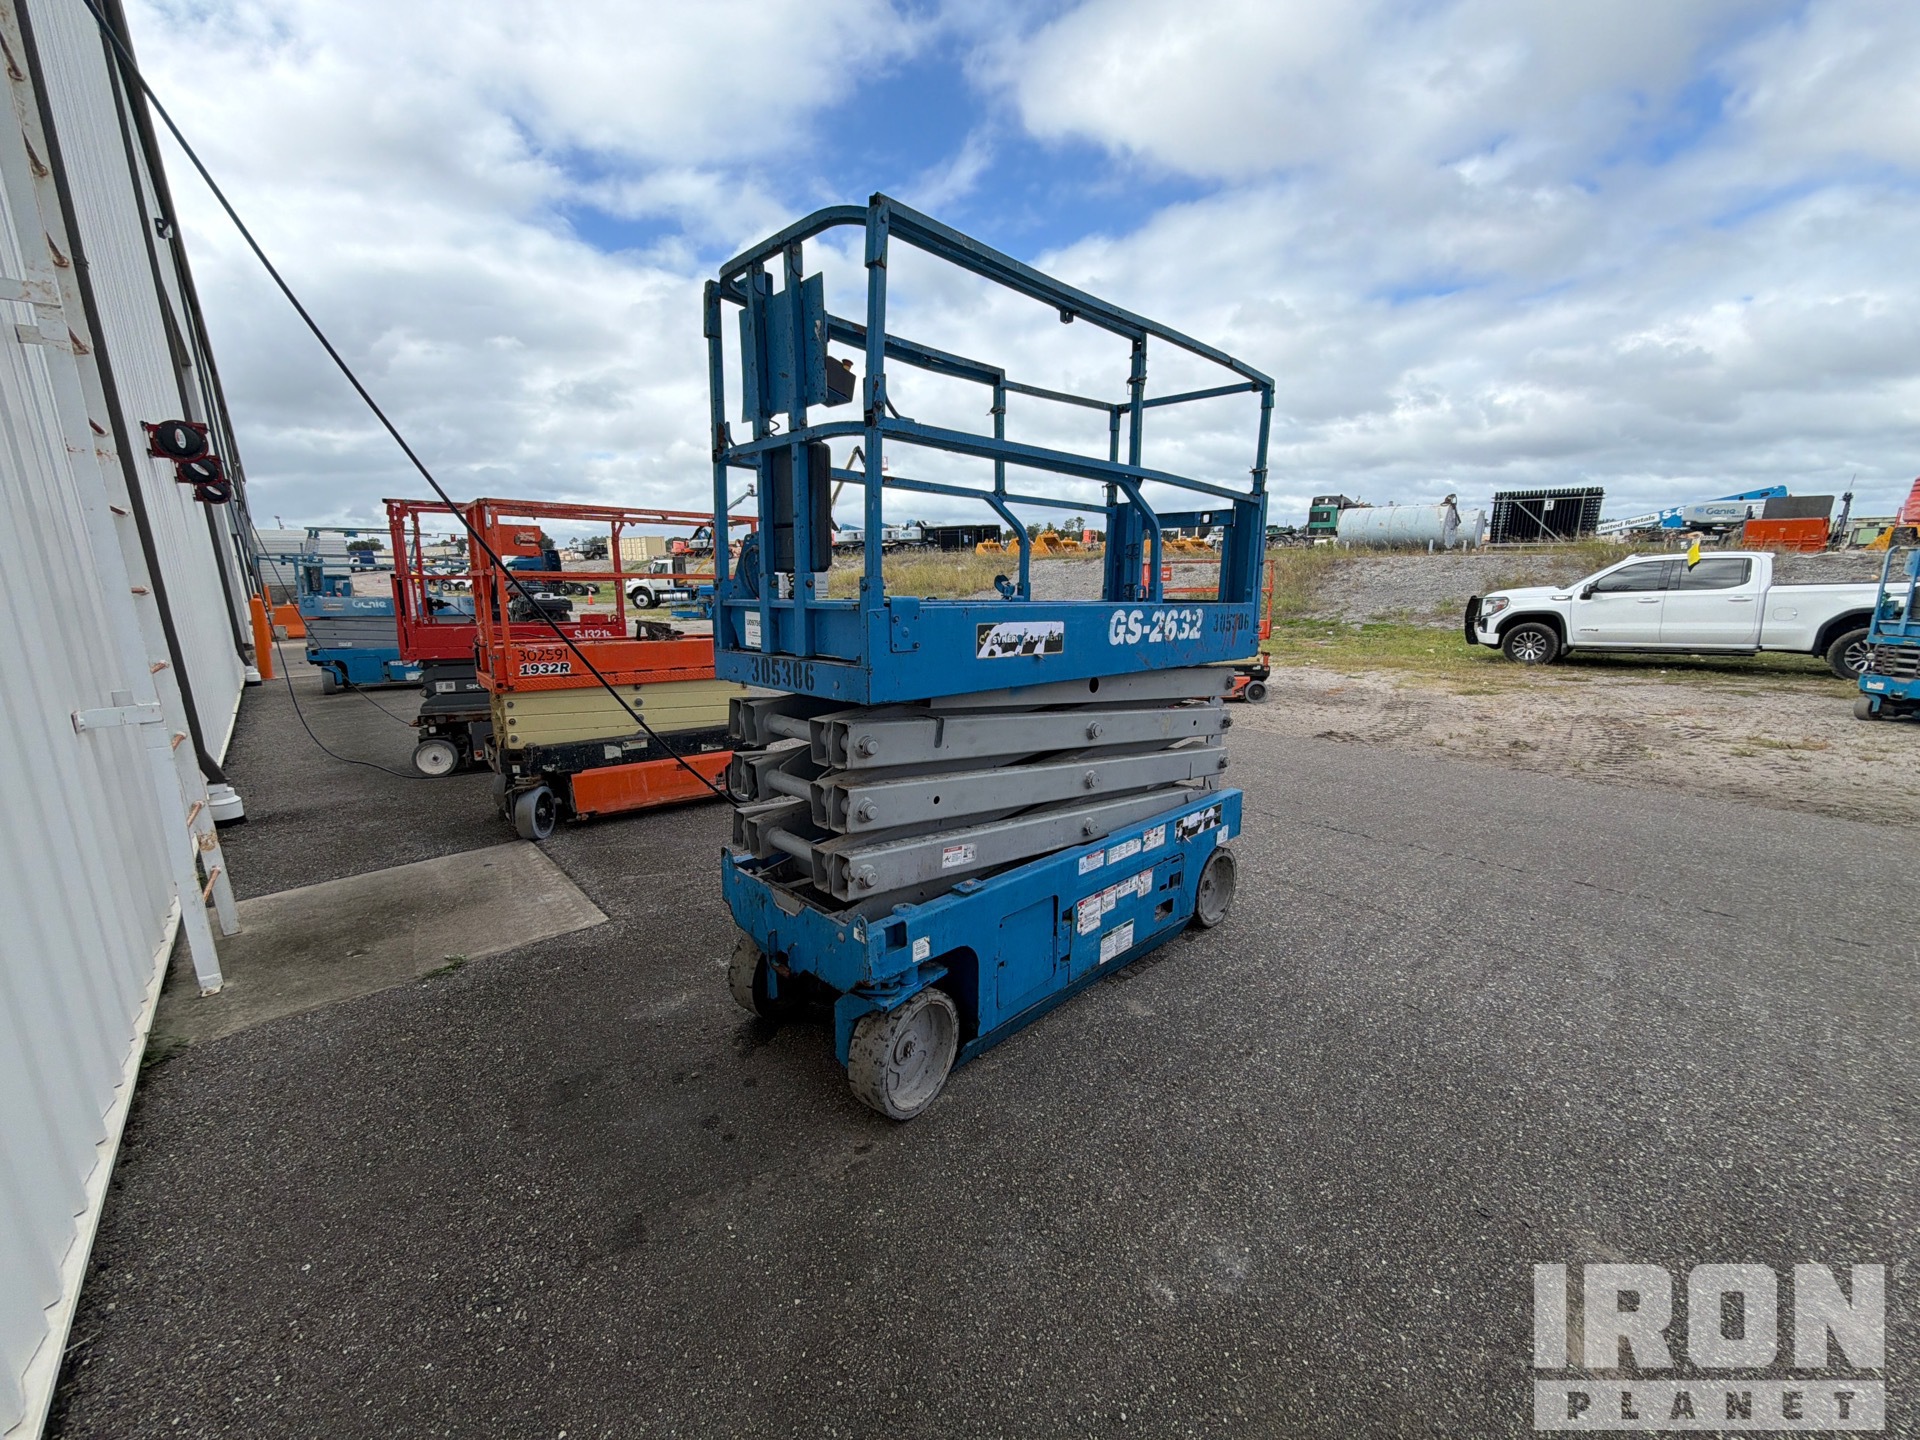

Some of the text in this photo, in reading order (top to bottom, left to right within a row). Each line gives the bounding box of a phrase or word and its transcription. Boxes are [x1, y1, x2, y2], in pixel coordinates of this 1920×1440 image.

[1705, 507, 1736, 515] Genie
[1596, 515, 1656, 532] United Rentals
[1108, 608, 1203, 646] GS-2632
[517, 648, 569, 662] 302591
[520, 662, 571, 676] 1932R
[751, 655, 815, 692] 305306
